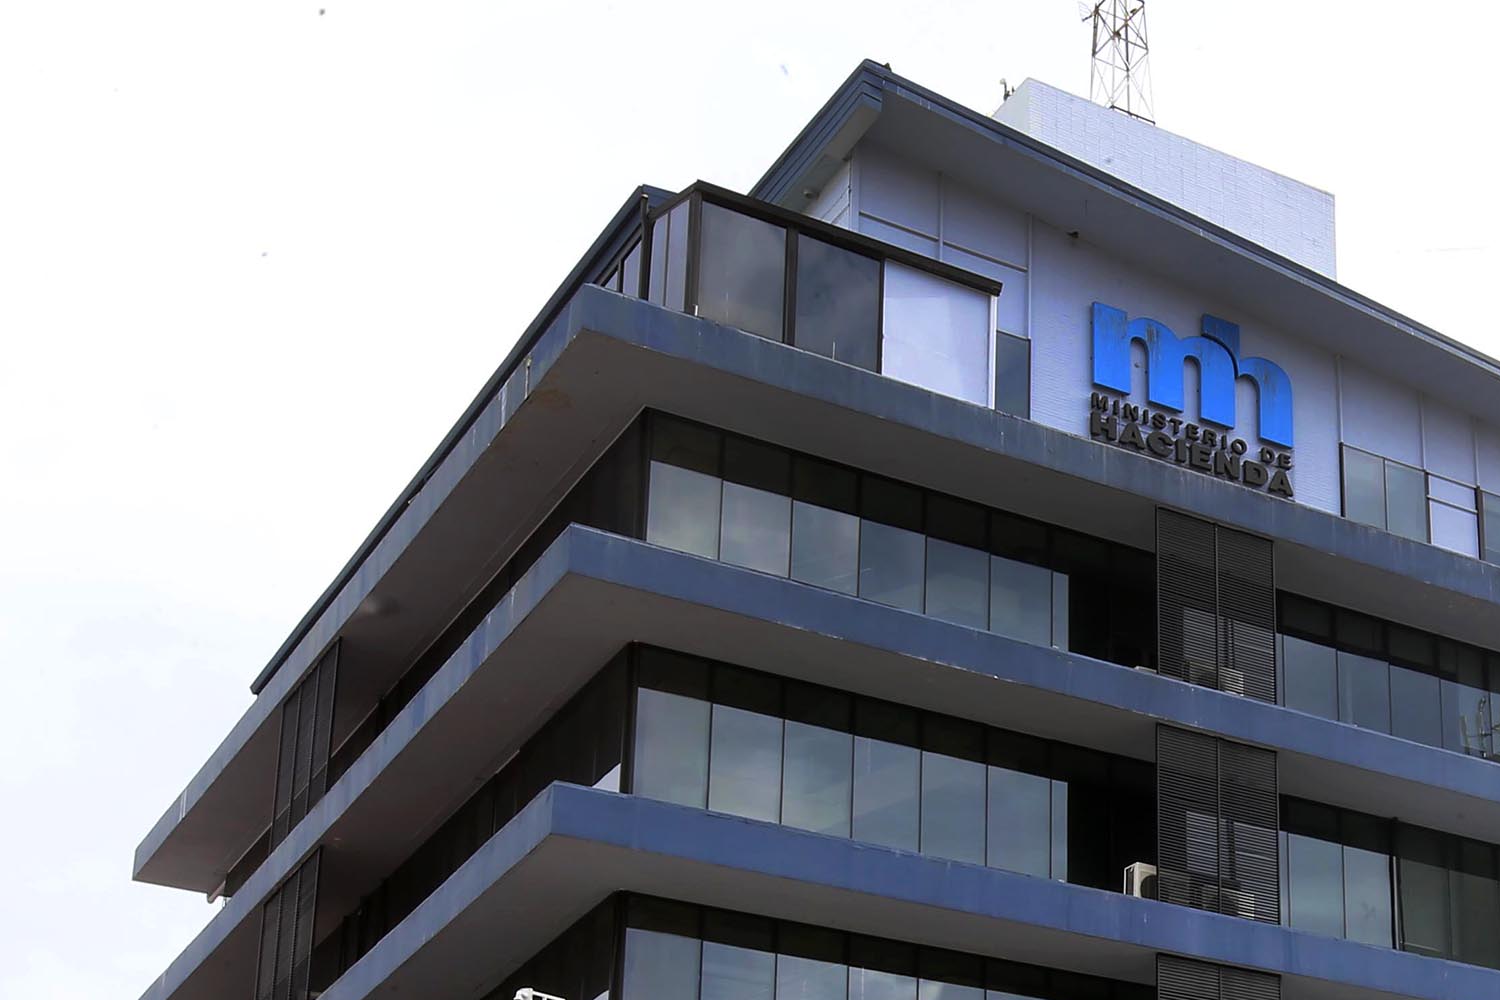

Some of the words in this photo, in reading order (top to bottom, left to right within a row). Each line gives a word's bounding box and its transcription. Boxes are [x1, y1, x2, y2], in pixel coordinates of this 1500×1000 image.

[1090, 392, 1249, 455] MINISTERIO
[1260, 446, 1293, 471] DE
[1090, 410, 1295, 498] HACIENDA
